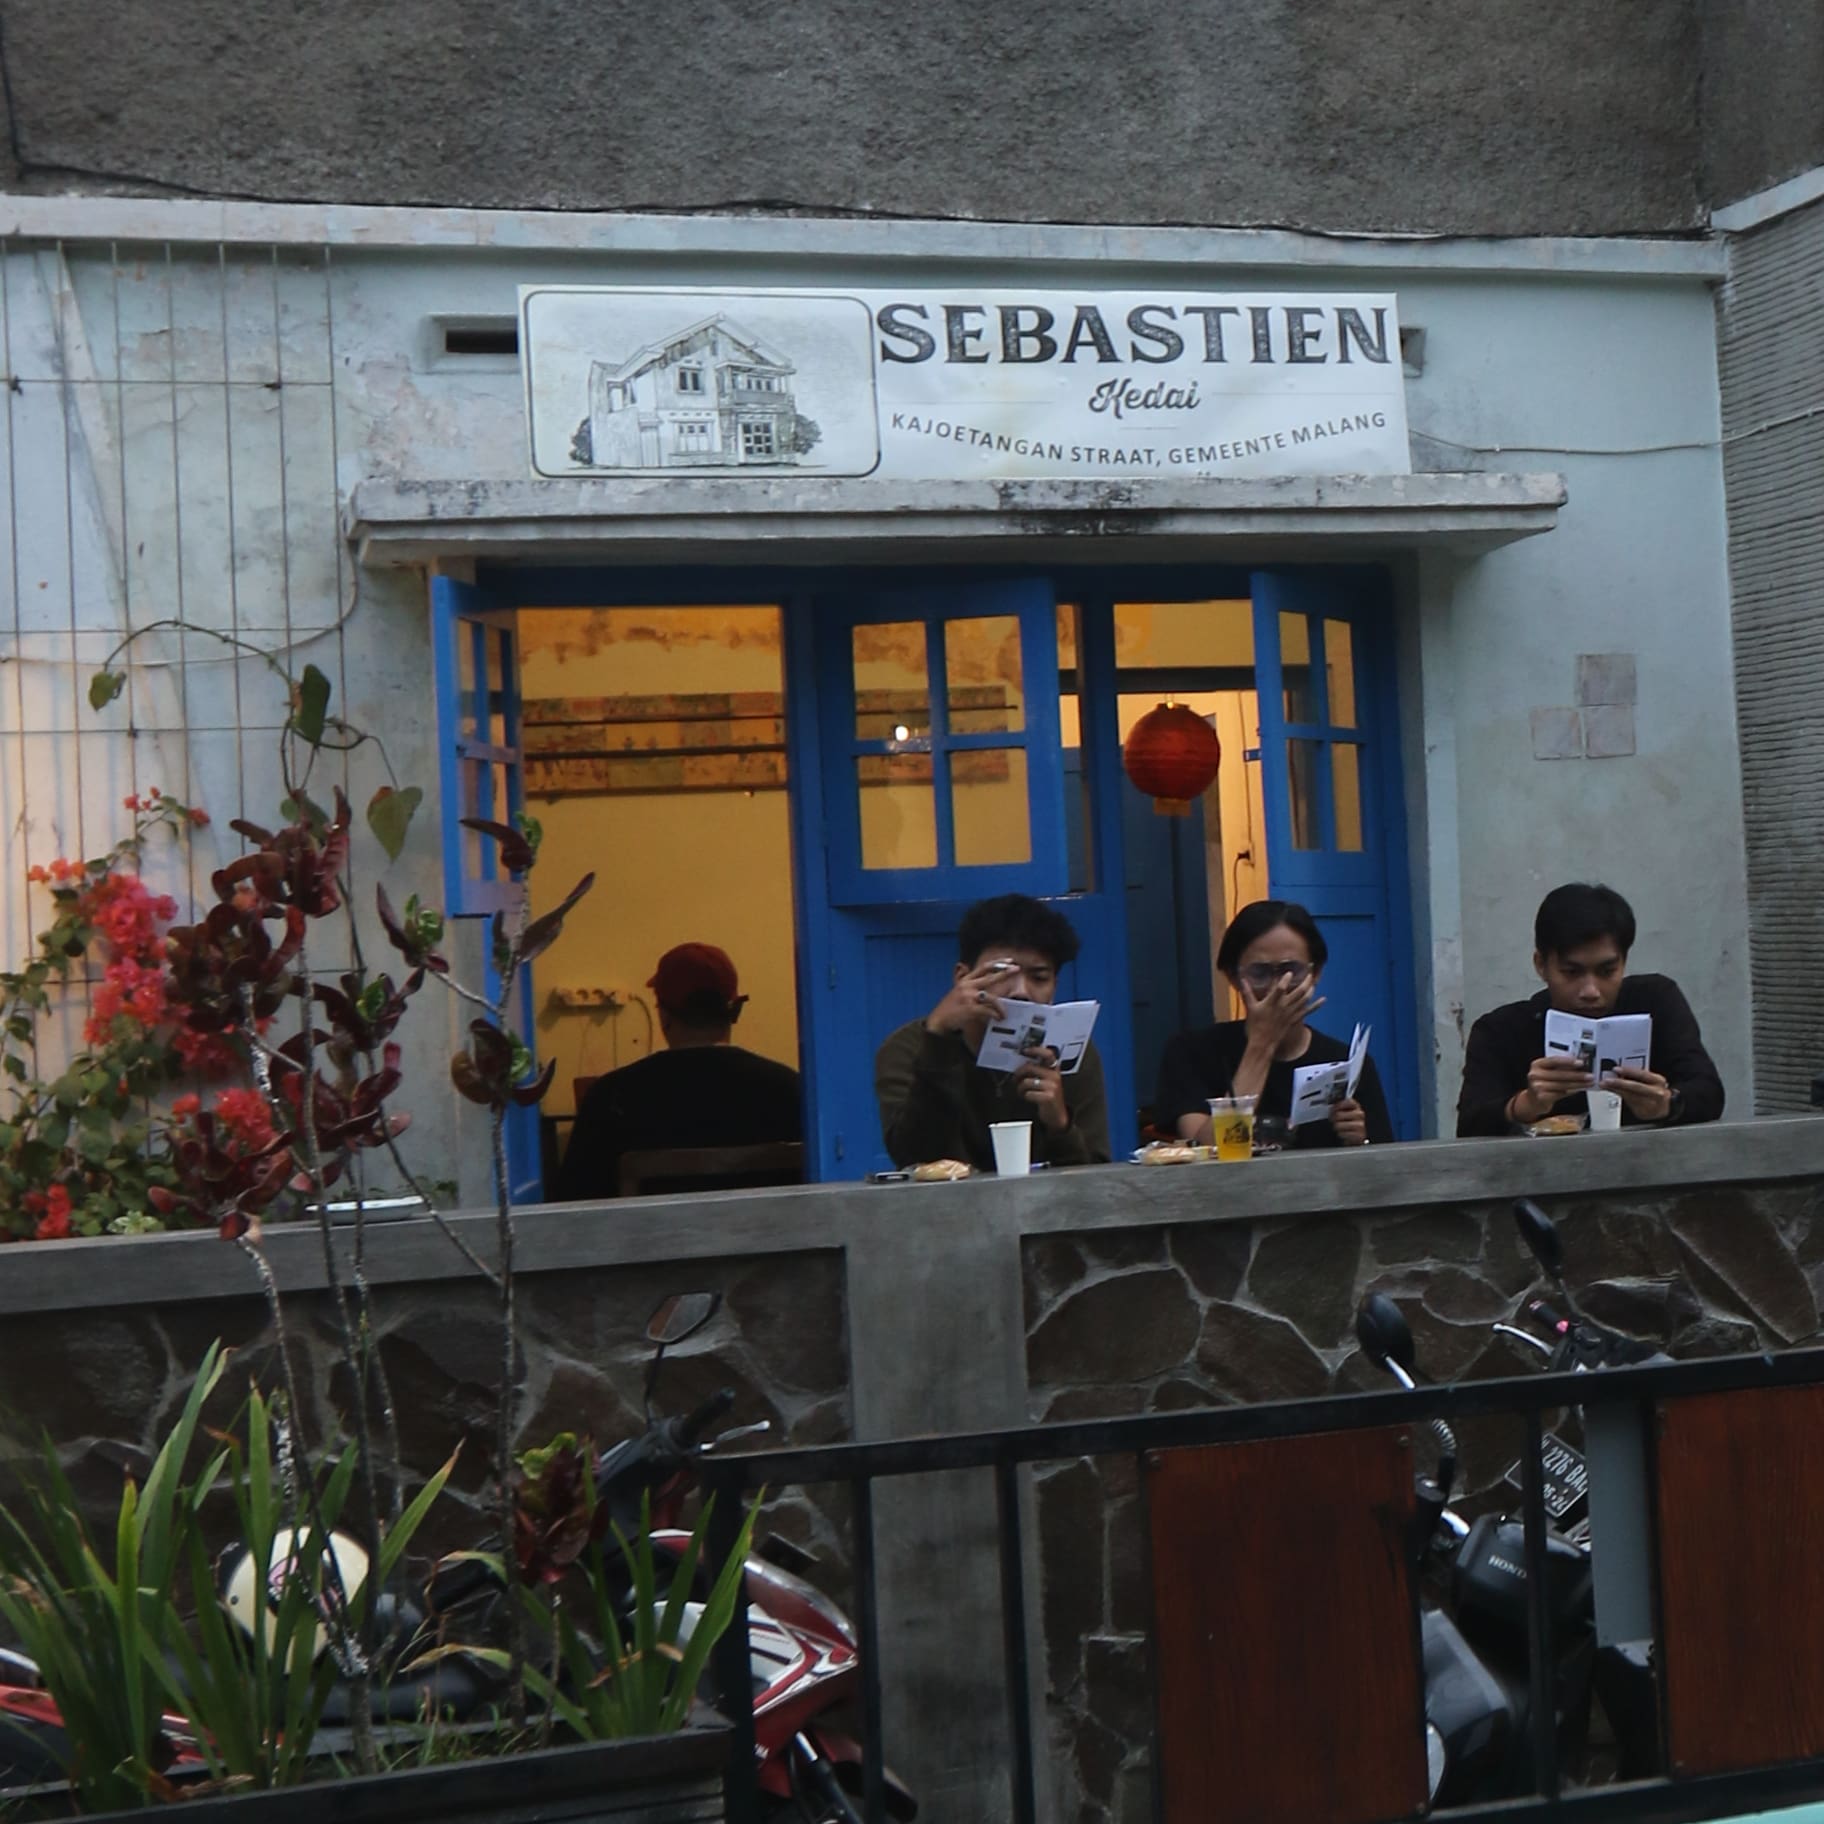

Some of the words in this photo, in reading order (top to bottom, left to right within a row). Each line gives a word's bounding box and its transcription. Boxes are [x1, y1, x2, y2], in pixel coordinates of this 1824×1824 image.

[877, 303, 1393, 365] SEBASTIEN
[1088, 378, 1201, 419] Kedai
[892, 412, 1064, 461] KAJOETANGAN
[1070, 446, 1162, 468] STRAAT,
[1168, 431, 1287, 465] GEMEENTE
[1292, 411, 1387, 446] MALANG
[1488, 1554, 1528, 1579] HOND
